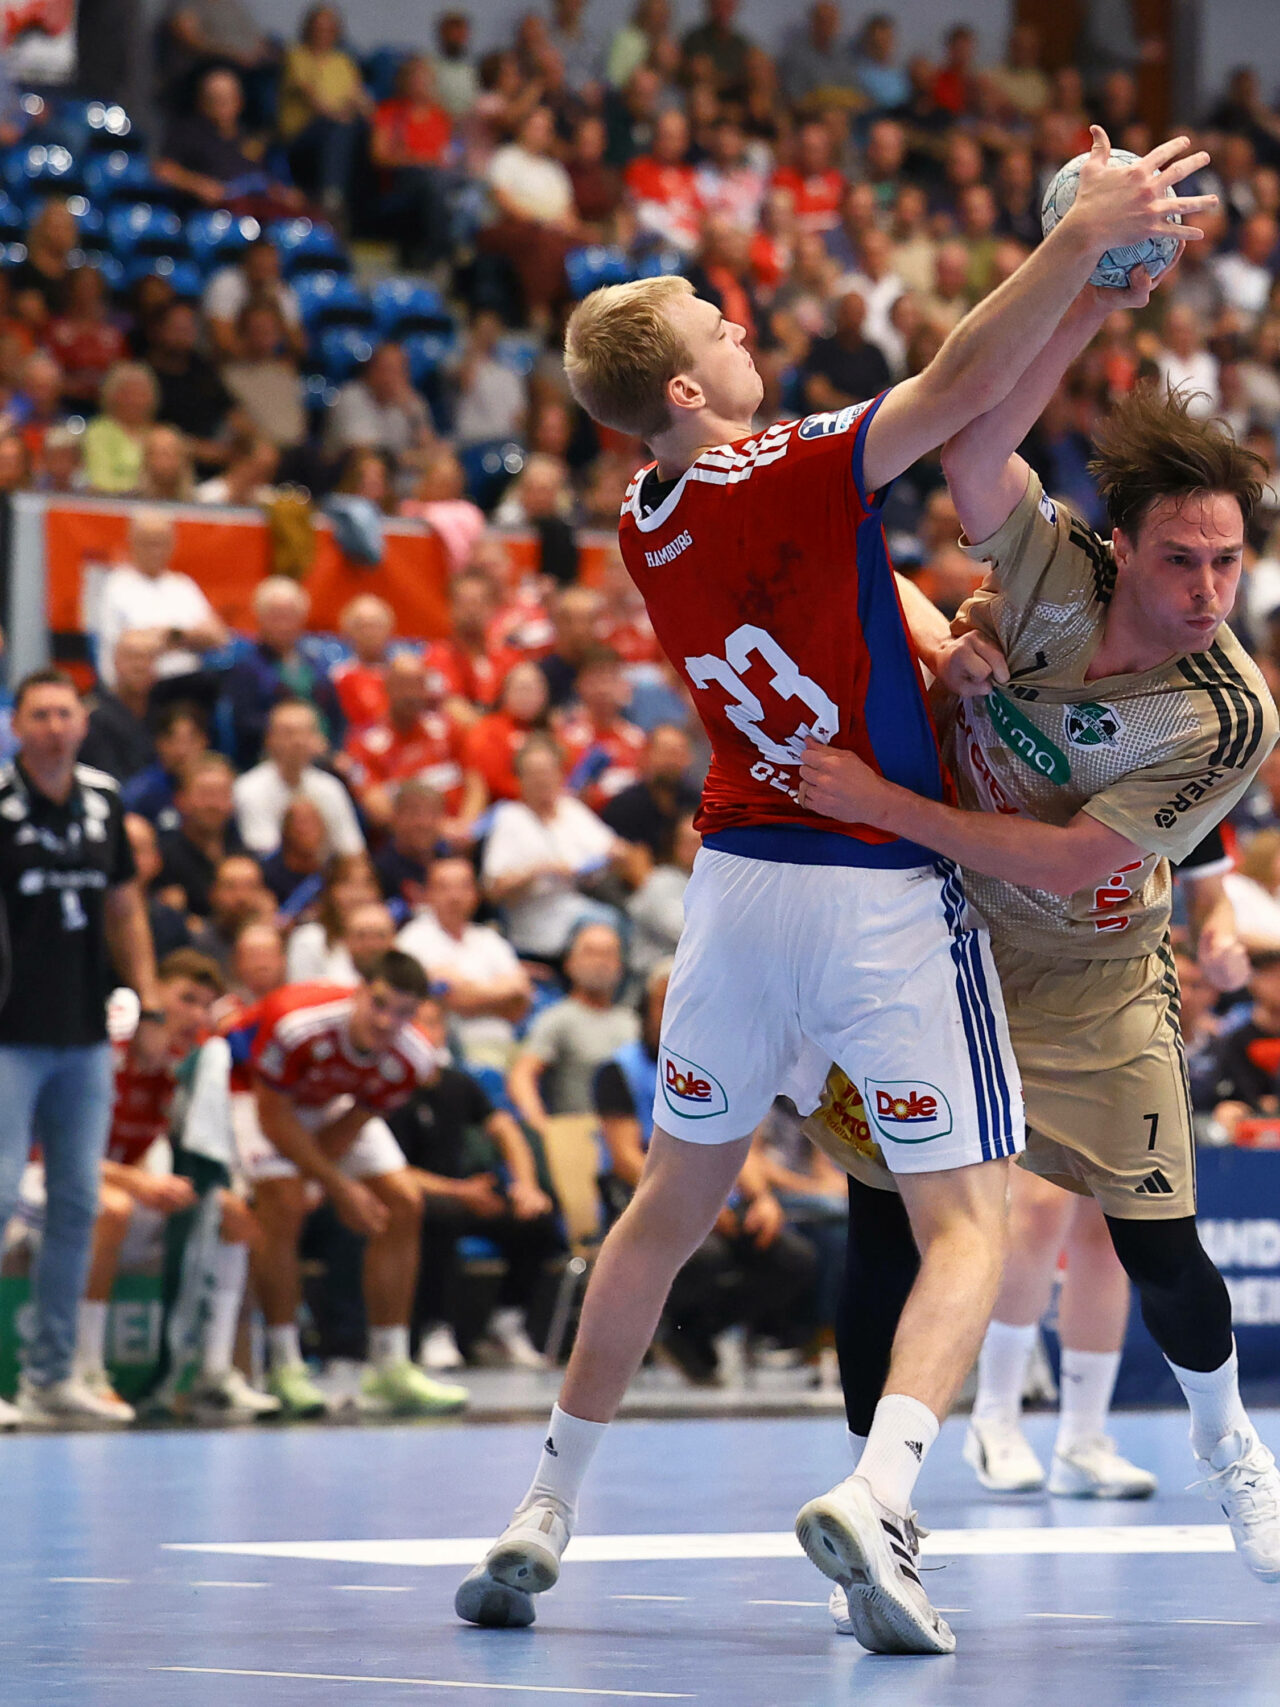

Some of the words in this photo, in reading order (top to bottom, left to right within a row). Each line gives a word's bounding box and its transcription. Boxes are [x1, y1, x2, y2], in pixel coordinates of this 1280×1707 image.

[644, 529, 693, 568] HAMBURG
[685, 623, 840, 766] 23
[667, 1059, 712, 1098] Dole
[876, 1090, 938, 1120] Dole
[1143, 1112, 1159, 1151] 7
